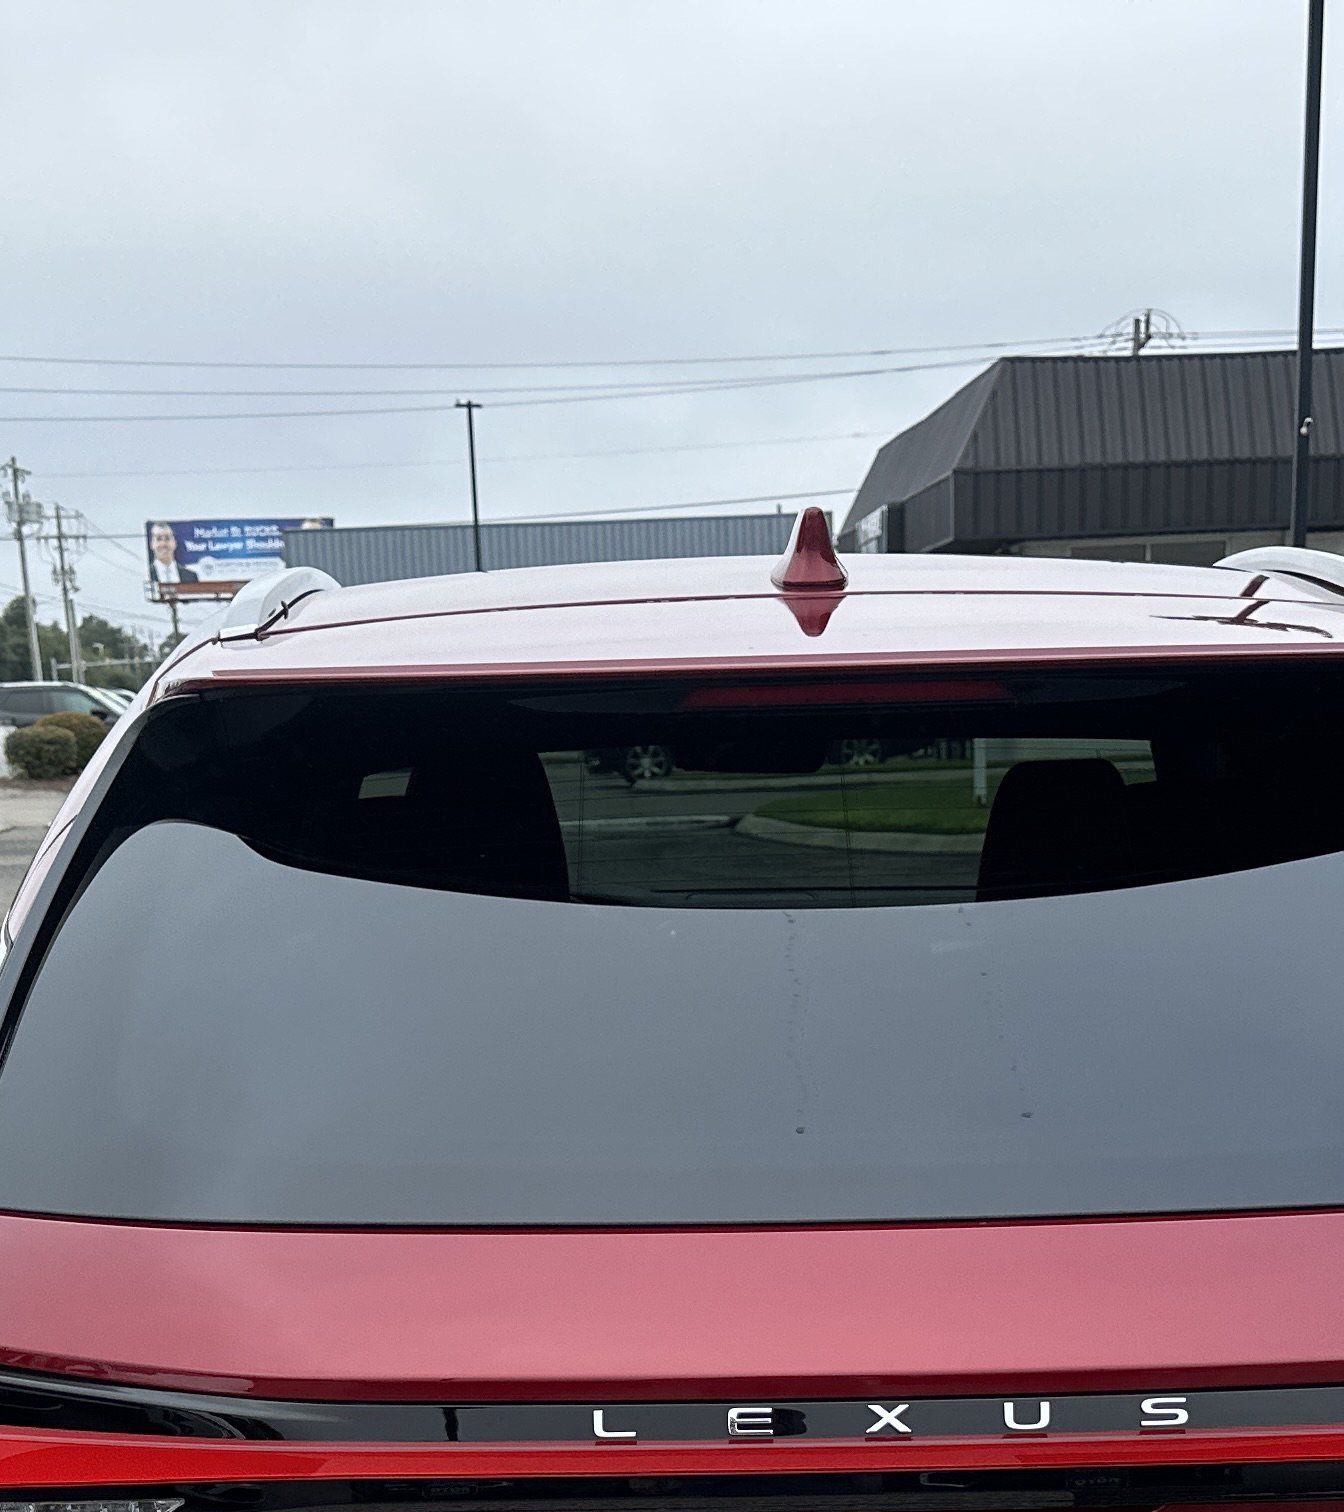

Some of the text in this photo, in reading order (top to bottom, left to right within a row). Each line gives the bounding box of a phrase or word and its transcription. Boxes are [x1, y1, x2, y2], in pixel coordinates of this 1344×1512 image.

[184, 540, 207, 552] Your
[208, 540, 244, 552] Lawyer
[593, 1397, 1188, 1438] LEXUS
